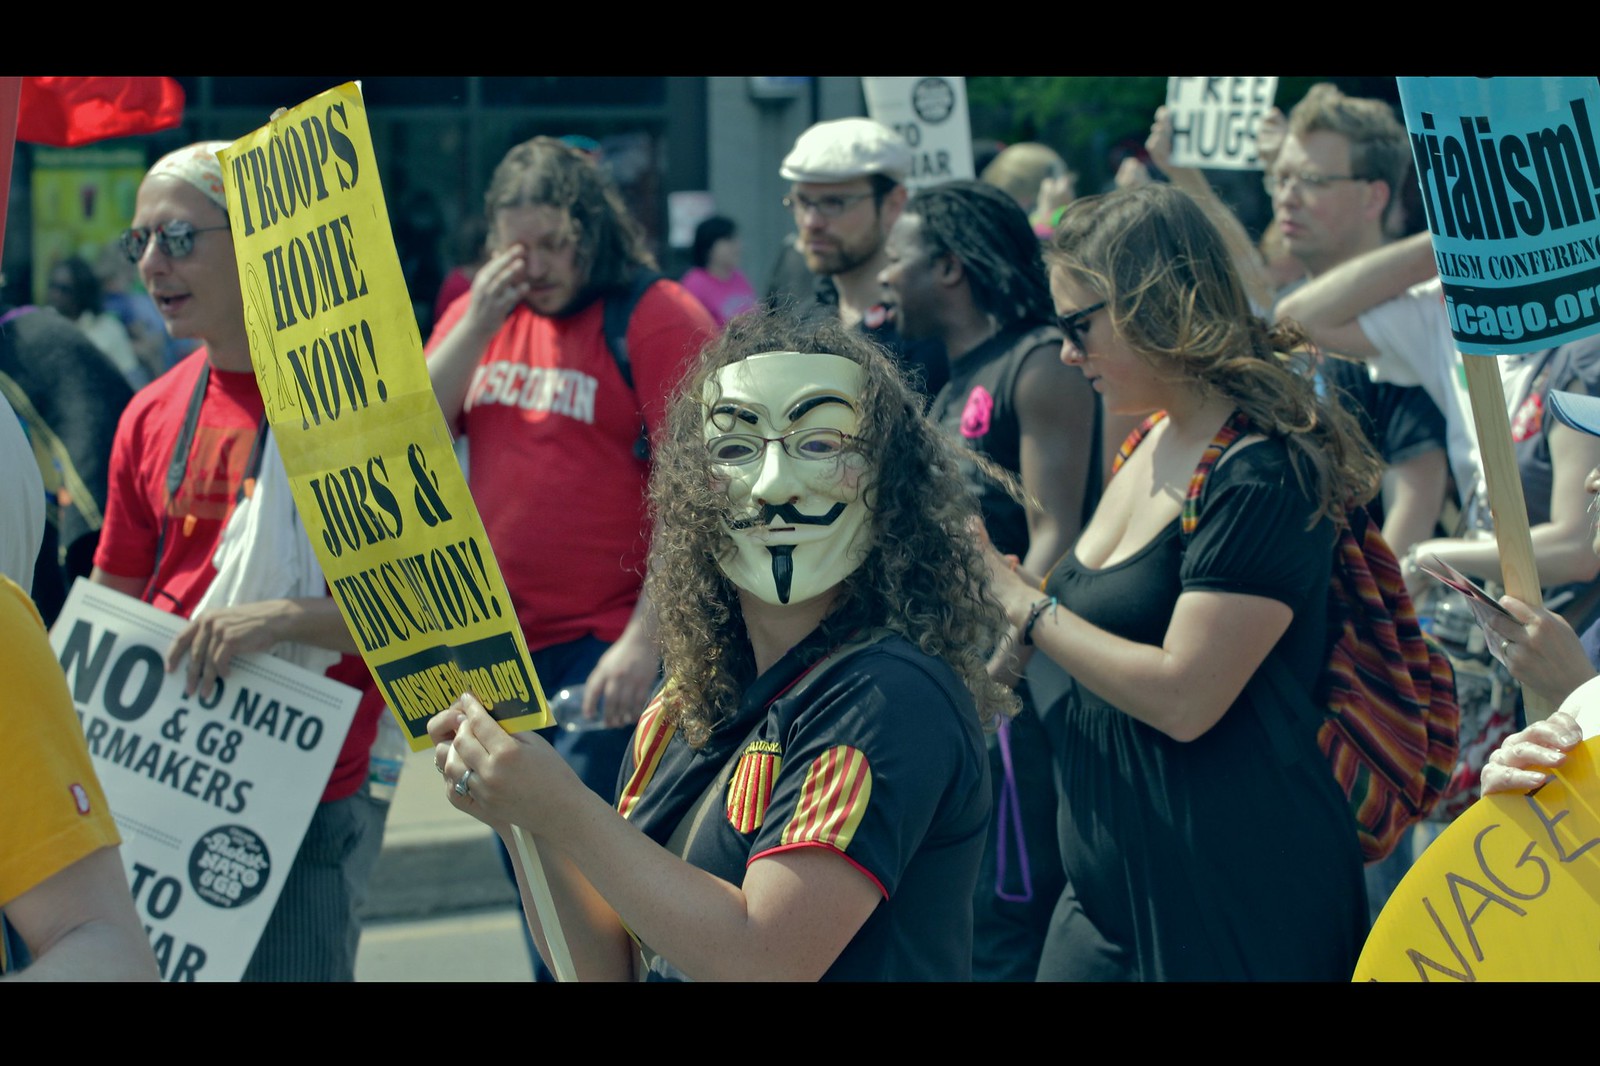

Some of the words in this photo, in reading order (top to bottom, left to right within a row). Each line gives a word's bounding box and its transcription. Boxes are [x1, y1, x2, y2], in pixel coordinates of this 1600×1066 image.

[232, 101, 360, 238] TROOPS
[262, 214, 369, 332] HOME
[286, 318, 388, 431] NOW!
[309, 455, 404, 558] JOBS
[407, 442, 453, 528] &
[59, 618, 165, 723] NO
[181, 675, 225, 711] O
[229, 686, 325, 752] NATO
[160, 707, 190, 744] &
[196, 720, 243, 765] G8
[76, 710, 254, 814] RMAKERS
[131, 861, 183, 921] TO
[144, 924, 208, 982] AR
